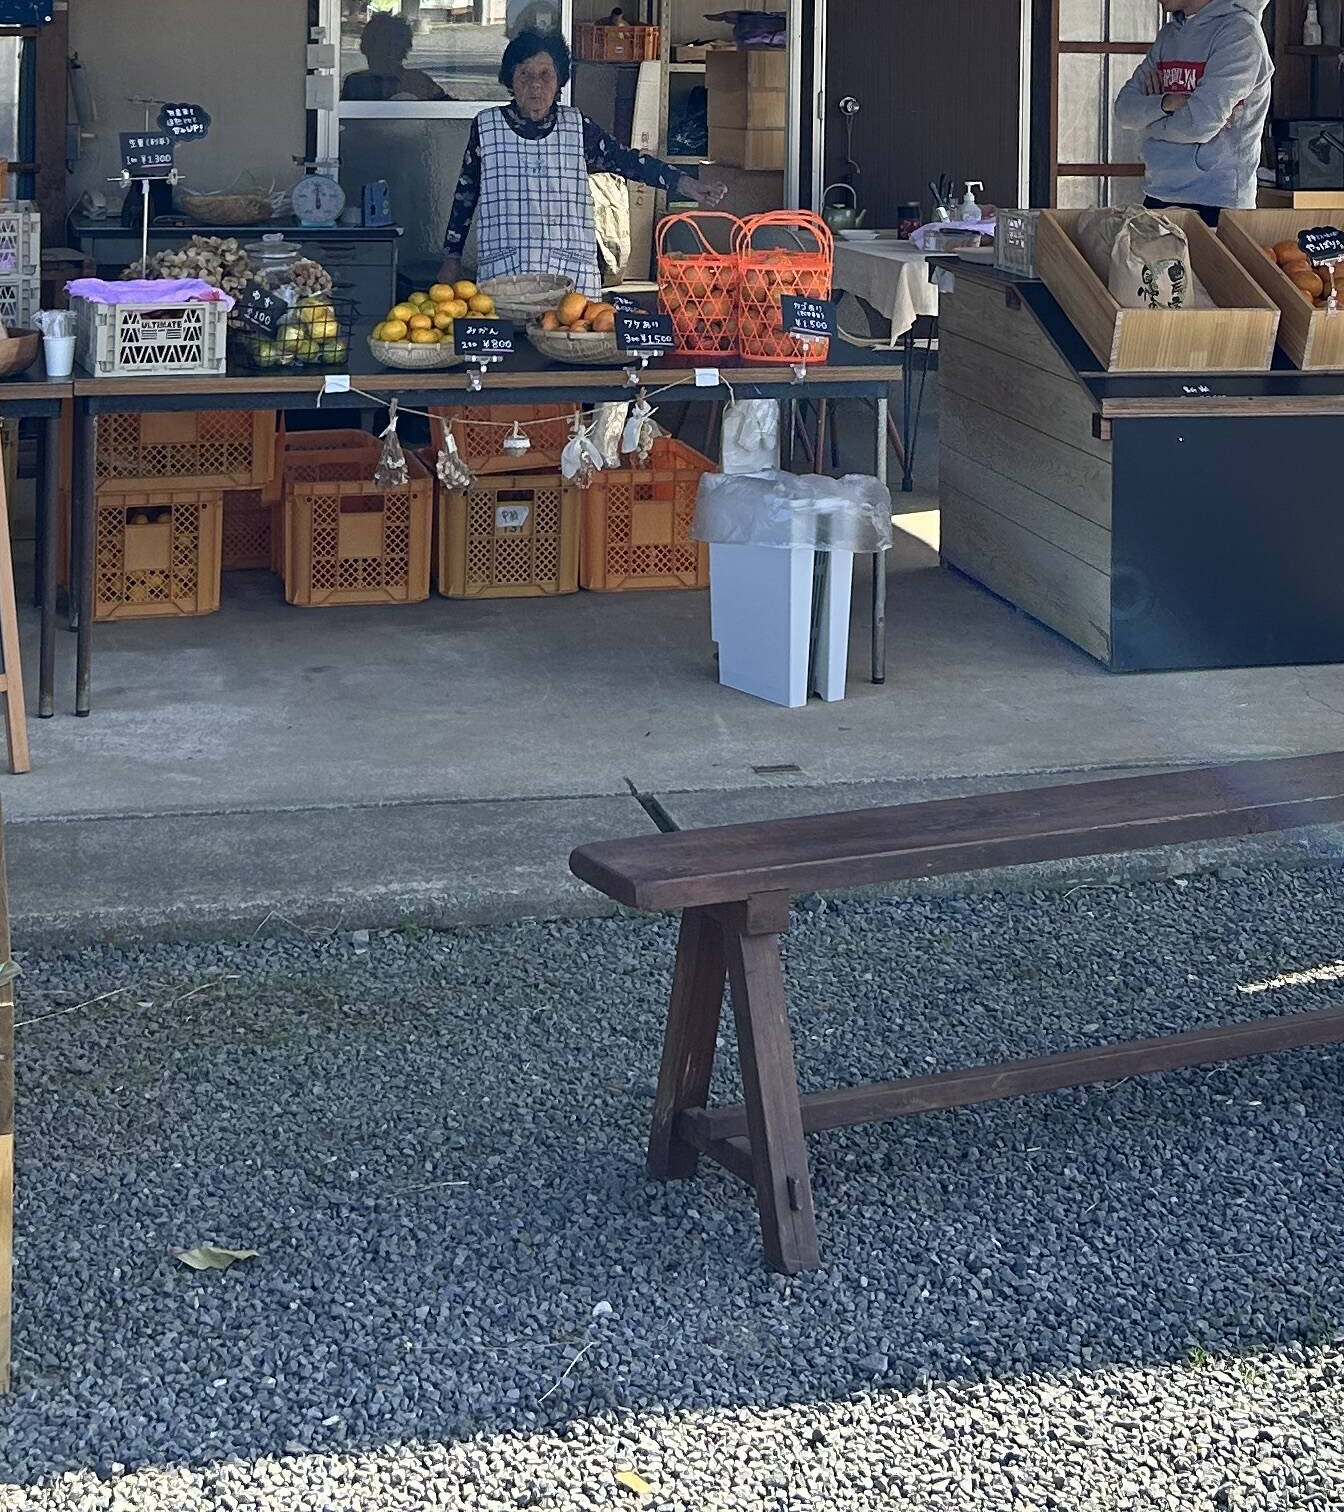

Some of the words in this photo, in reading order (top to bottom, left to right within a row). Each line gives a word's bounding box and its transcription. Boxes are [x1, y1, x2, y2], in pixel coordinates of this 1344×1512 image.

[141, 320, 183, 329] ULTIMATE
[466, 326, 499, 335] みかん
[482, 339, 512, 348] ¥800
